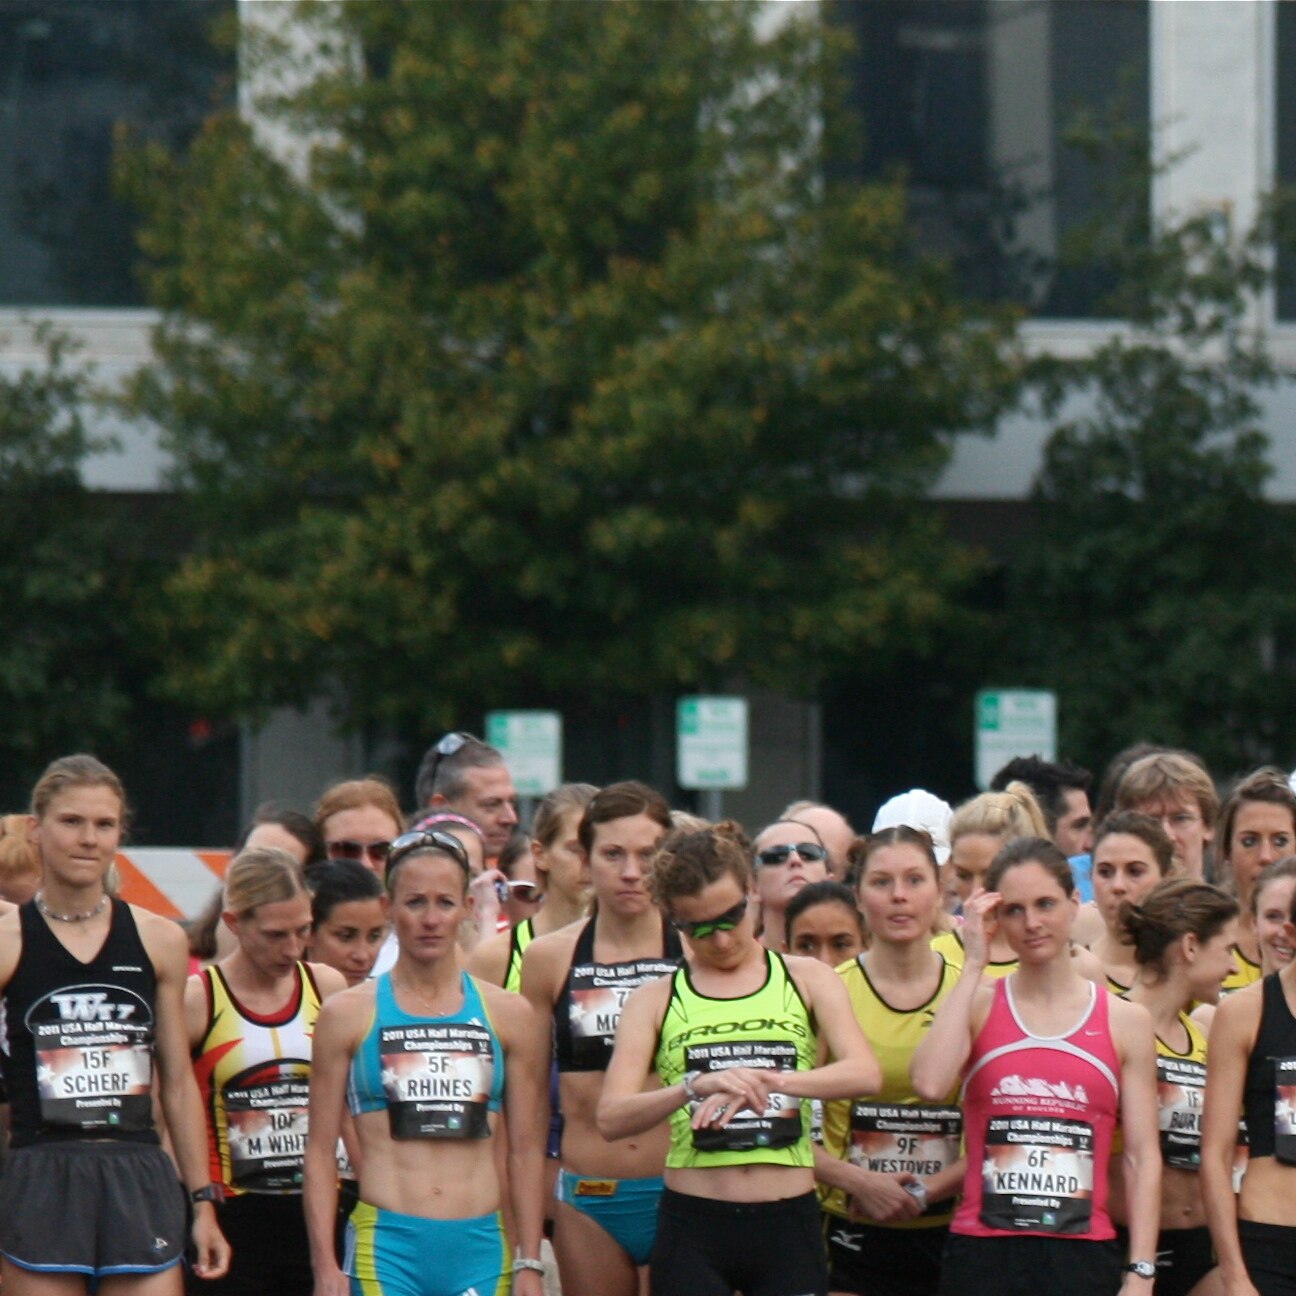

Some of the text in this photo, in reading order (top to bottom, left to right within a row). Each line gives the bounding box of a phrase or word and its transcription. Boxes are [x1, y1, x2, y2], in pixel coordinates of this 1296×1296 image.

[574, 963, 678, 977] 2011 USA Half Marathon
[38, 1022, 147, 1036] 2011 USA Half Marathon
[383, 1028, 489, 1041] 2011 USA Half Marathon
[668, 1018, 807, 1052] BROOKS
[60, 1033, 128, 1046] Championships
[404, 1040, 473, 1051] Championships
[82, 1050, 111, 1069] 15F
[688, 1045, 796, 1059] 2011 USA Half Marathon
[429, 1056, 450, 1073] 5F
[709, 1058, 776, 1070] Championships
[63, 1073, 129, 1093] SCHERF
[407, 1079, 472, 1097] RHINES
[1187, 1091, 1198, 1107] 1F
[416, 1103, 464, 1112] Presented By
[856, 1106, 961, 1120] 2011 USA Half Marathon
[270, 1113, 296, 1131] 10F
[876, 1119, 942, 1132] Championships
[990, 1120, 1092, 1136] 2011 USA Half Marathon
[249, 1135, 309, 1155] M WHIT
[897, 1137, 918, 1155] 9F
[1007, 1132, 1073, 1146] Championships
[868, 1158, 942, 1175] WESTOVER
[1027, 1150, 1050, 1167] 6F
[997, 1172, 1078, 1193] KENNARD
[1012, 1196, 1061, 1209] Presented By
